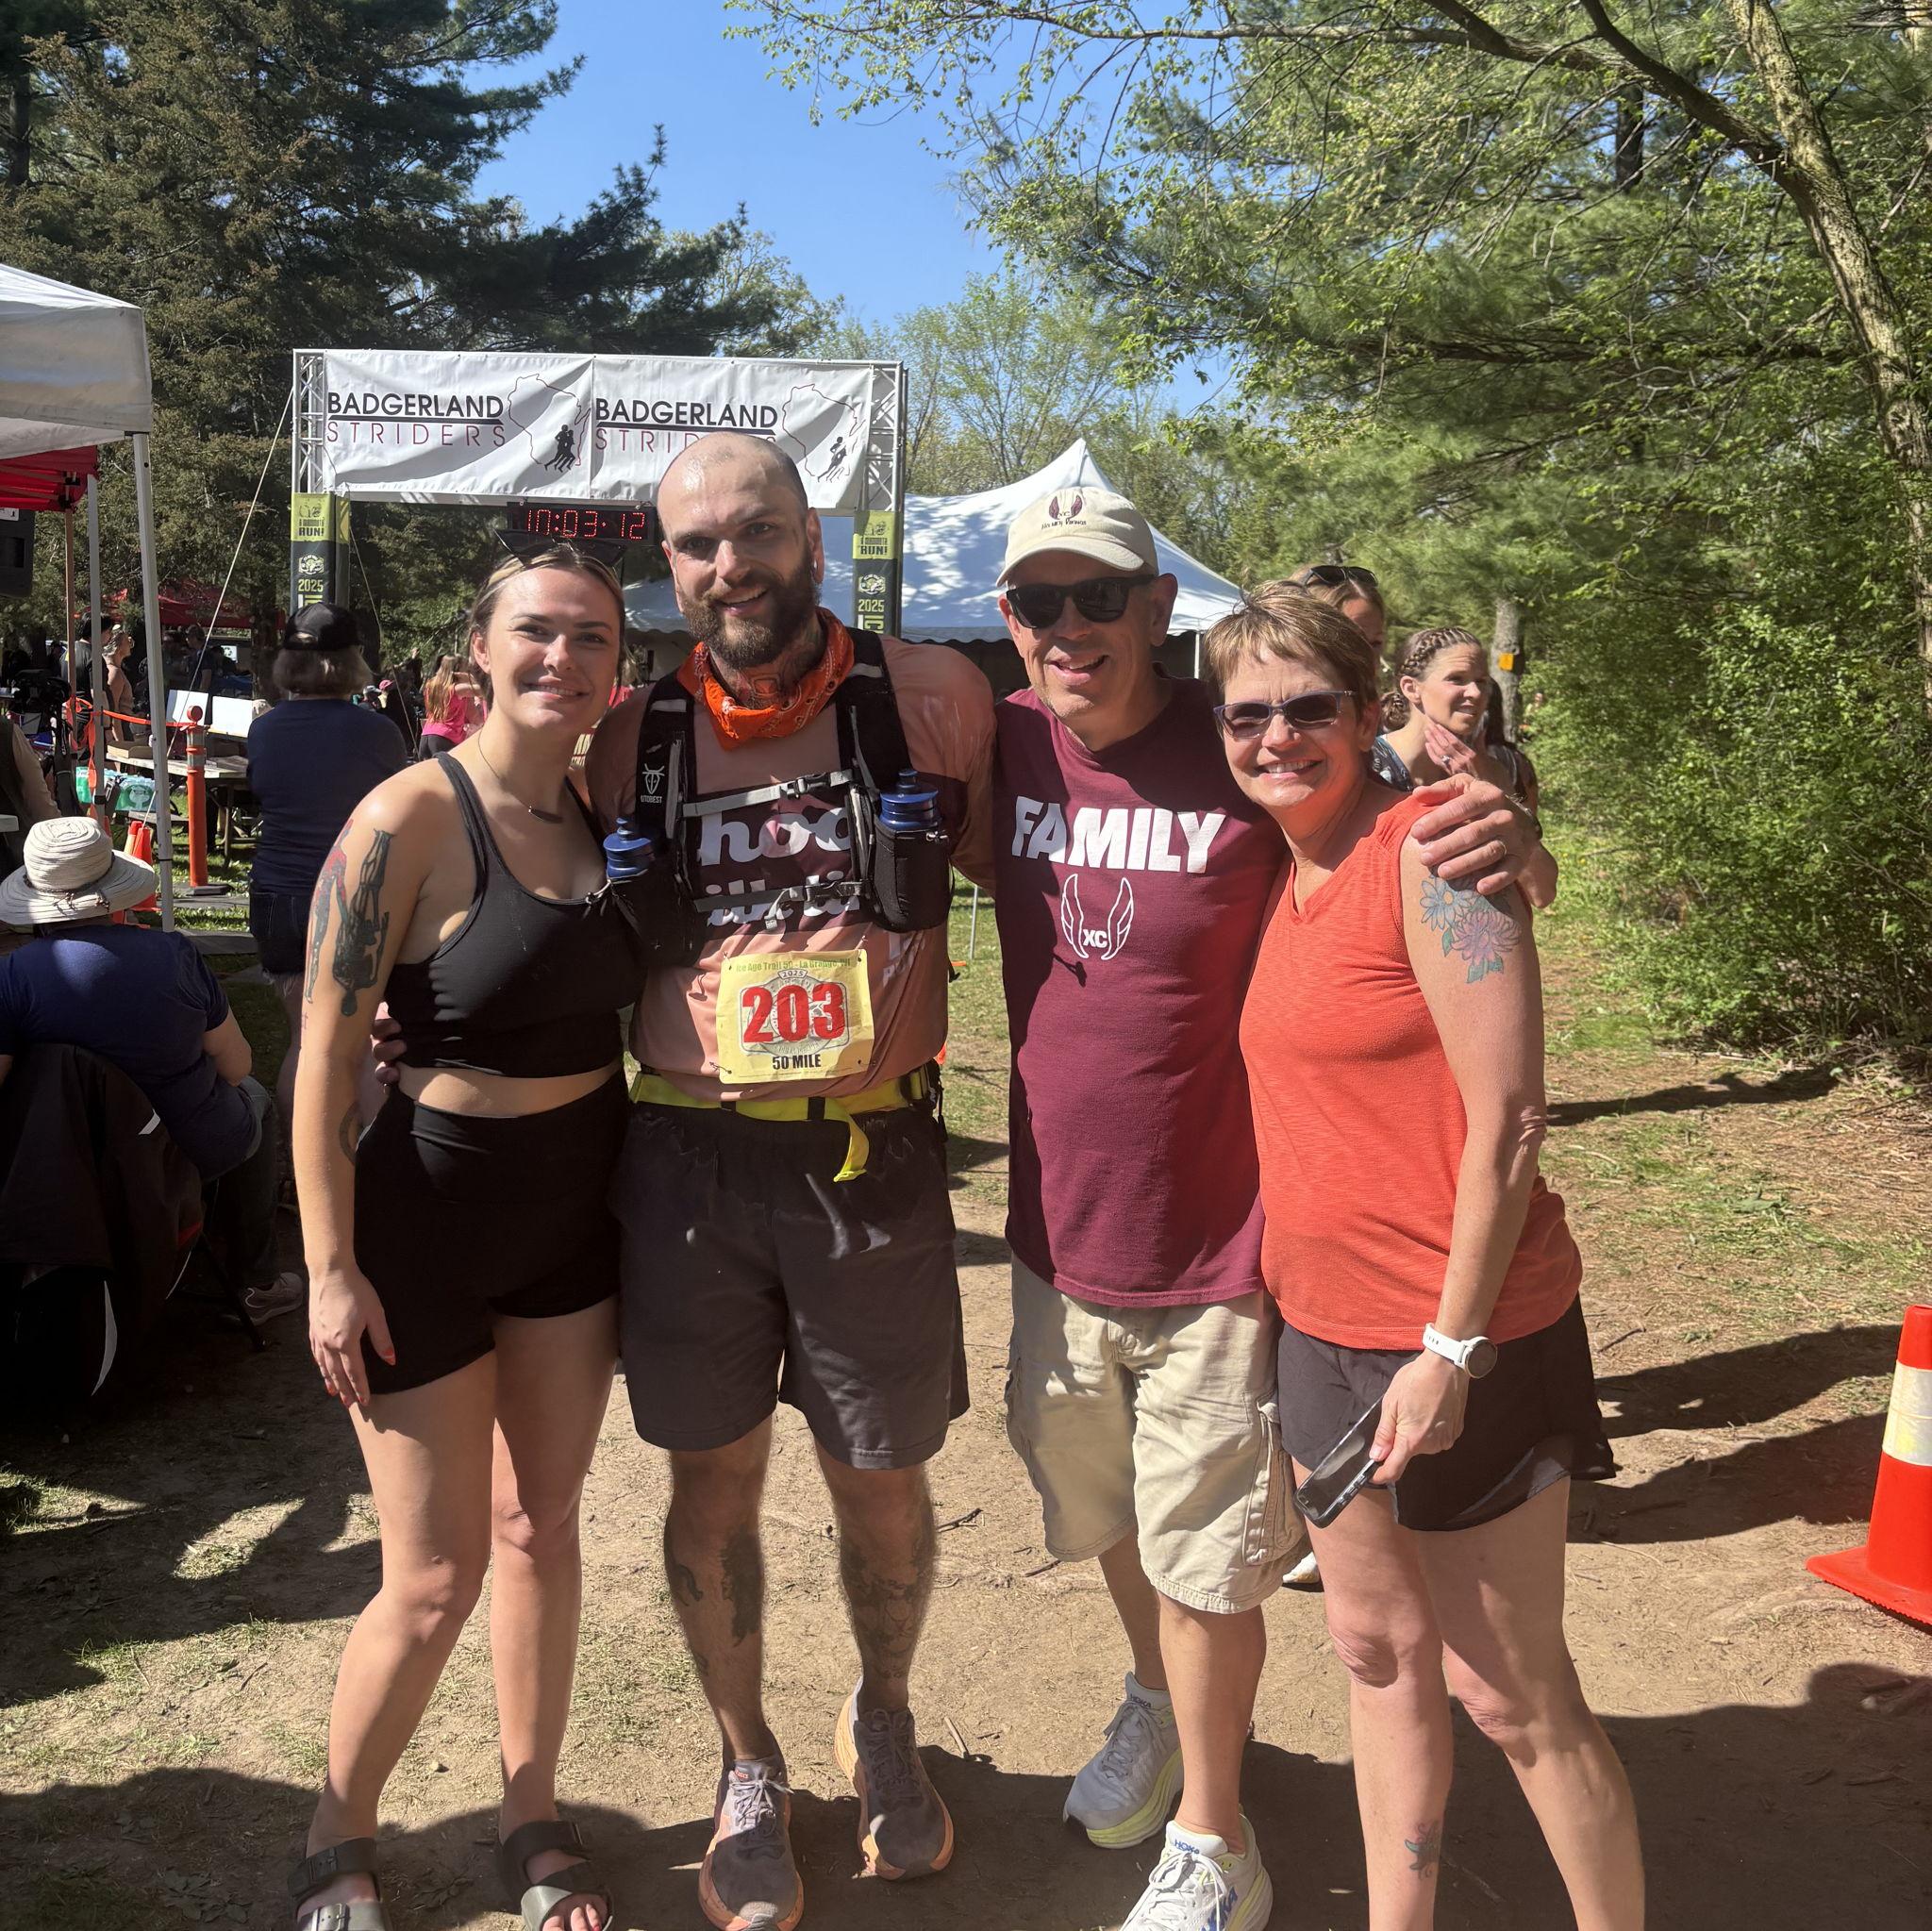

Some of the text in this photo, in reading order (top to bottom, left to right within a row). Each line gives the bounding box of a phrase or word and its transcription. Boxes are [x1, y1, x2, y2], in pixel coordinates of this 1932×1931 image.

[327, 391, 504, 418] BADGERLAND
[595, 397, 778, 428] BADGERLAND
[326, 421, 506, 447] STRIDERS
[298, 526, 325, 537] RUN!
[860, 545, 888, 556] RUN!
[298, 579, 324, 592] 2025
[858, 599, 885, 612] 2025
[1011, 795, 1226, 874] FAMILY
[1082, 928, 1108, 949] XC
[747, 962, 762, 973] Age
[763, 961, 782, 970] Trail
[799, 960, 809, 969] La
[782, 970, 805, 978] 2025
[741, 983, 845, 1043] 203
[772, 1054, 822, 1070] 50 MILE
